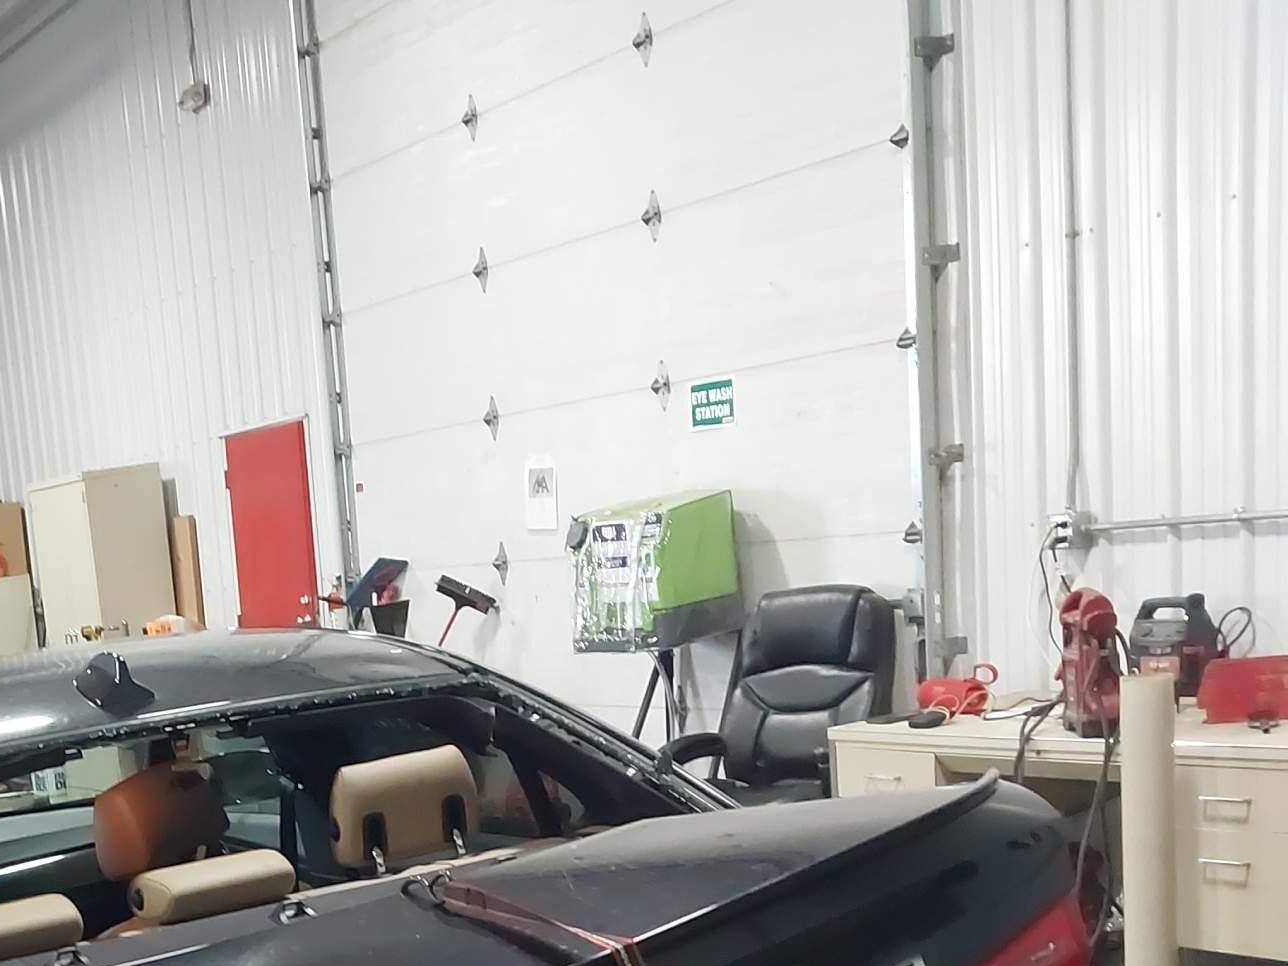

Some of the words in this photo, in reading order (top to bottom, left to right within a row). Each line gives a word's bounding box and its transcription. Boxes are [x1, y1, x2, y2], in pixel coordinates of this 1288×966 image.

[691, 390, 708, 405] EYE
[708, 386, 733, 403] WASH
[695, 403, 731, 421] STATION
